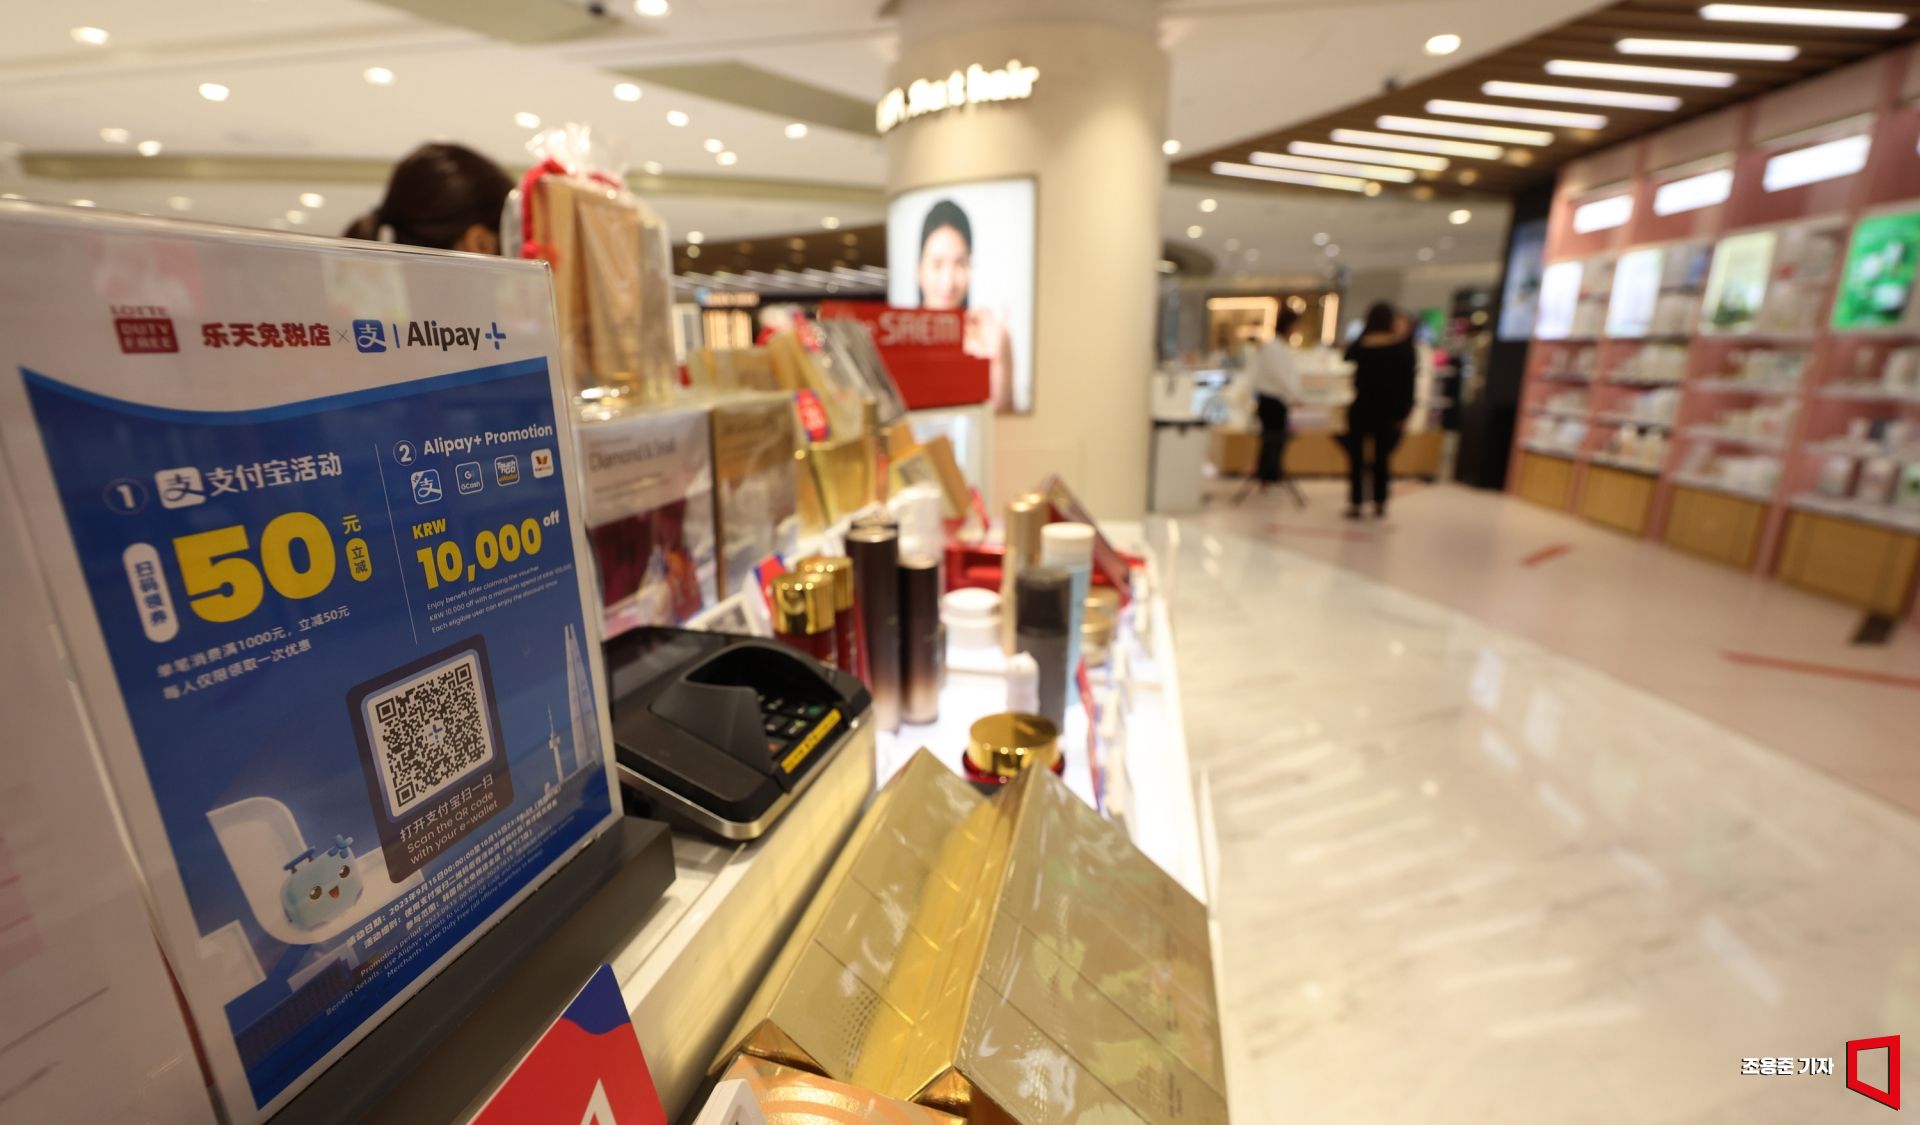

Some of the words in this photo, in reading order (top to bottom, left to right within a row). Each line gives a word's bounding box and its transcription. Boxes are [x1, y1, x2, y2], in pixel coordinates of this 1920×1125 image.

[201, 322, 332, 348] 乐天免税店
[423, 434, 482, 457] Alipay+
[484, 423, 553, 446] Promotion
[205, 451, 343, 497] 支付宝活动
[342, 514, 362, 536] 元
[412, 518, 447, 540] KRW
[351, 545, 369, 575] 立减
[416, 517, 542, 591] 10,000
[543, 510, 560, 528] off
[172, 511, 336, 623] 50
[427, 600, 445, 610] Enjoy
[445, 590, 468, 604] benefit
[431, 622, 448, 633] Each
[399, 773, 494, 843] 打开支付宝扫一扫
[407, 831, 435, 853] Scan
[436, 818, 453, 834] the
[455, 807, 469, 821] QR
[470, 791, 494, 811] code
[410, 845, 434, 864] with
[434, 828, 457, 851] your
[459, 800, 498, 831] e-wallet
[360, 945, 399, 977] Promotion
[325, 990, 354, 1016] Benefit
